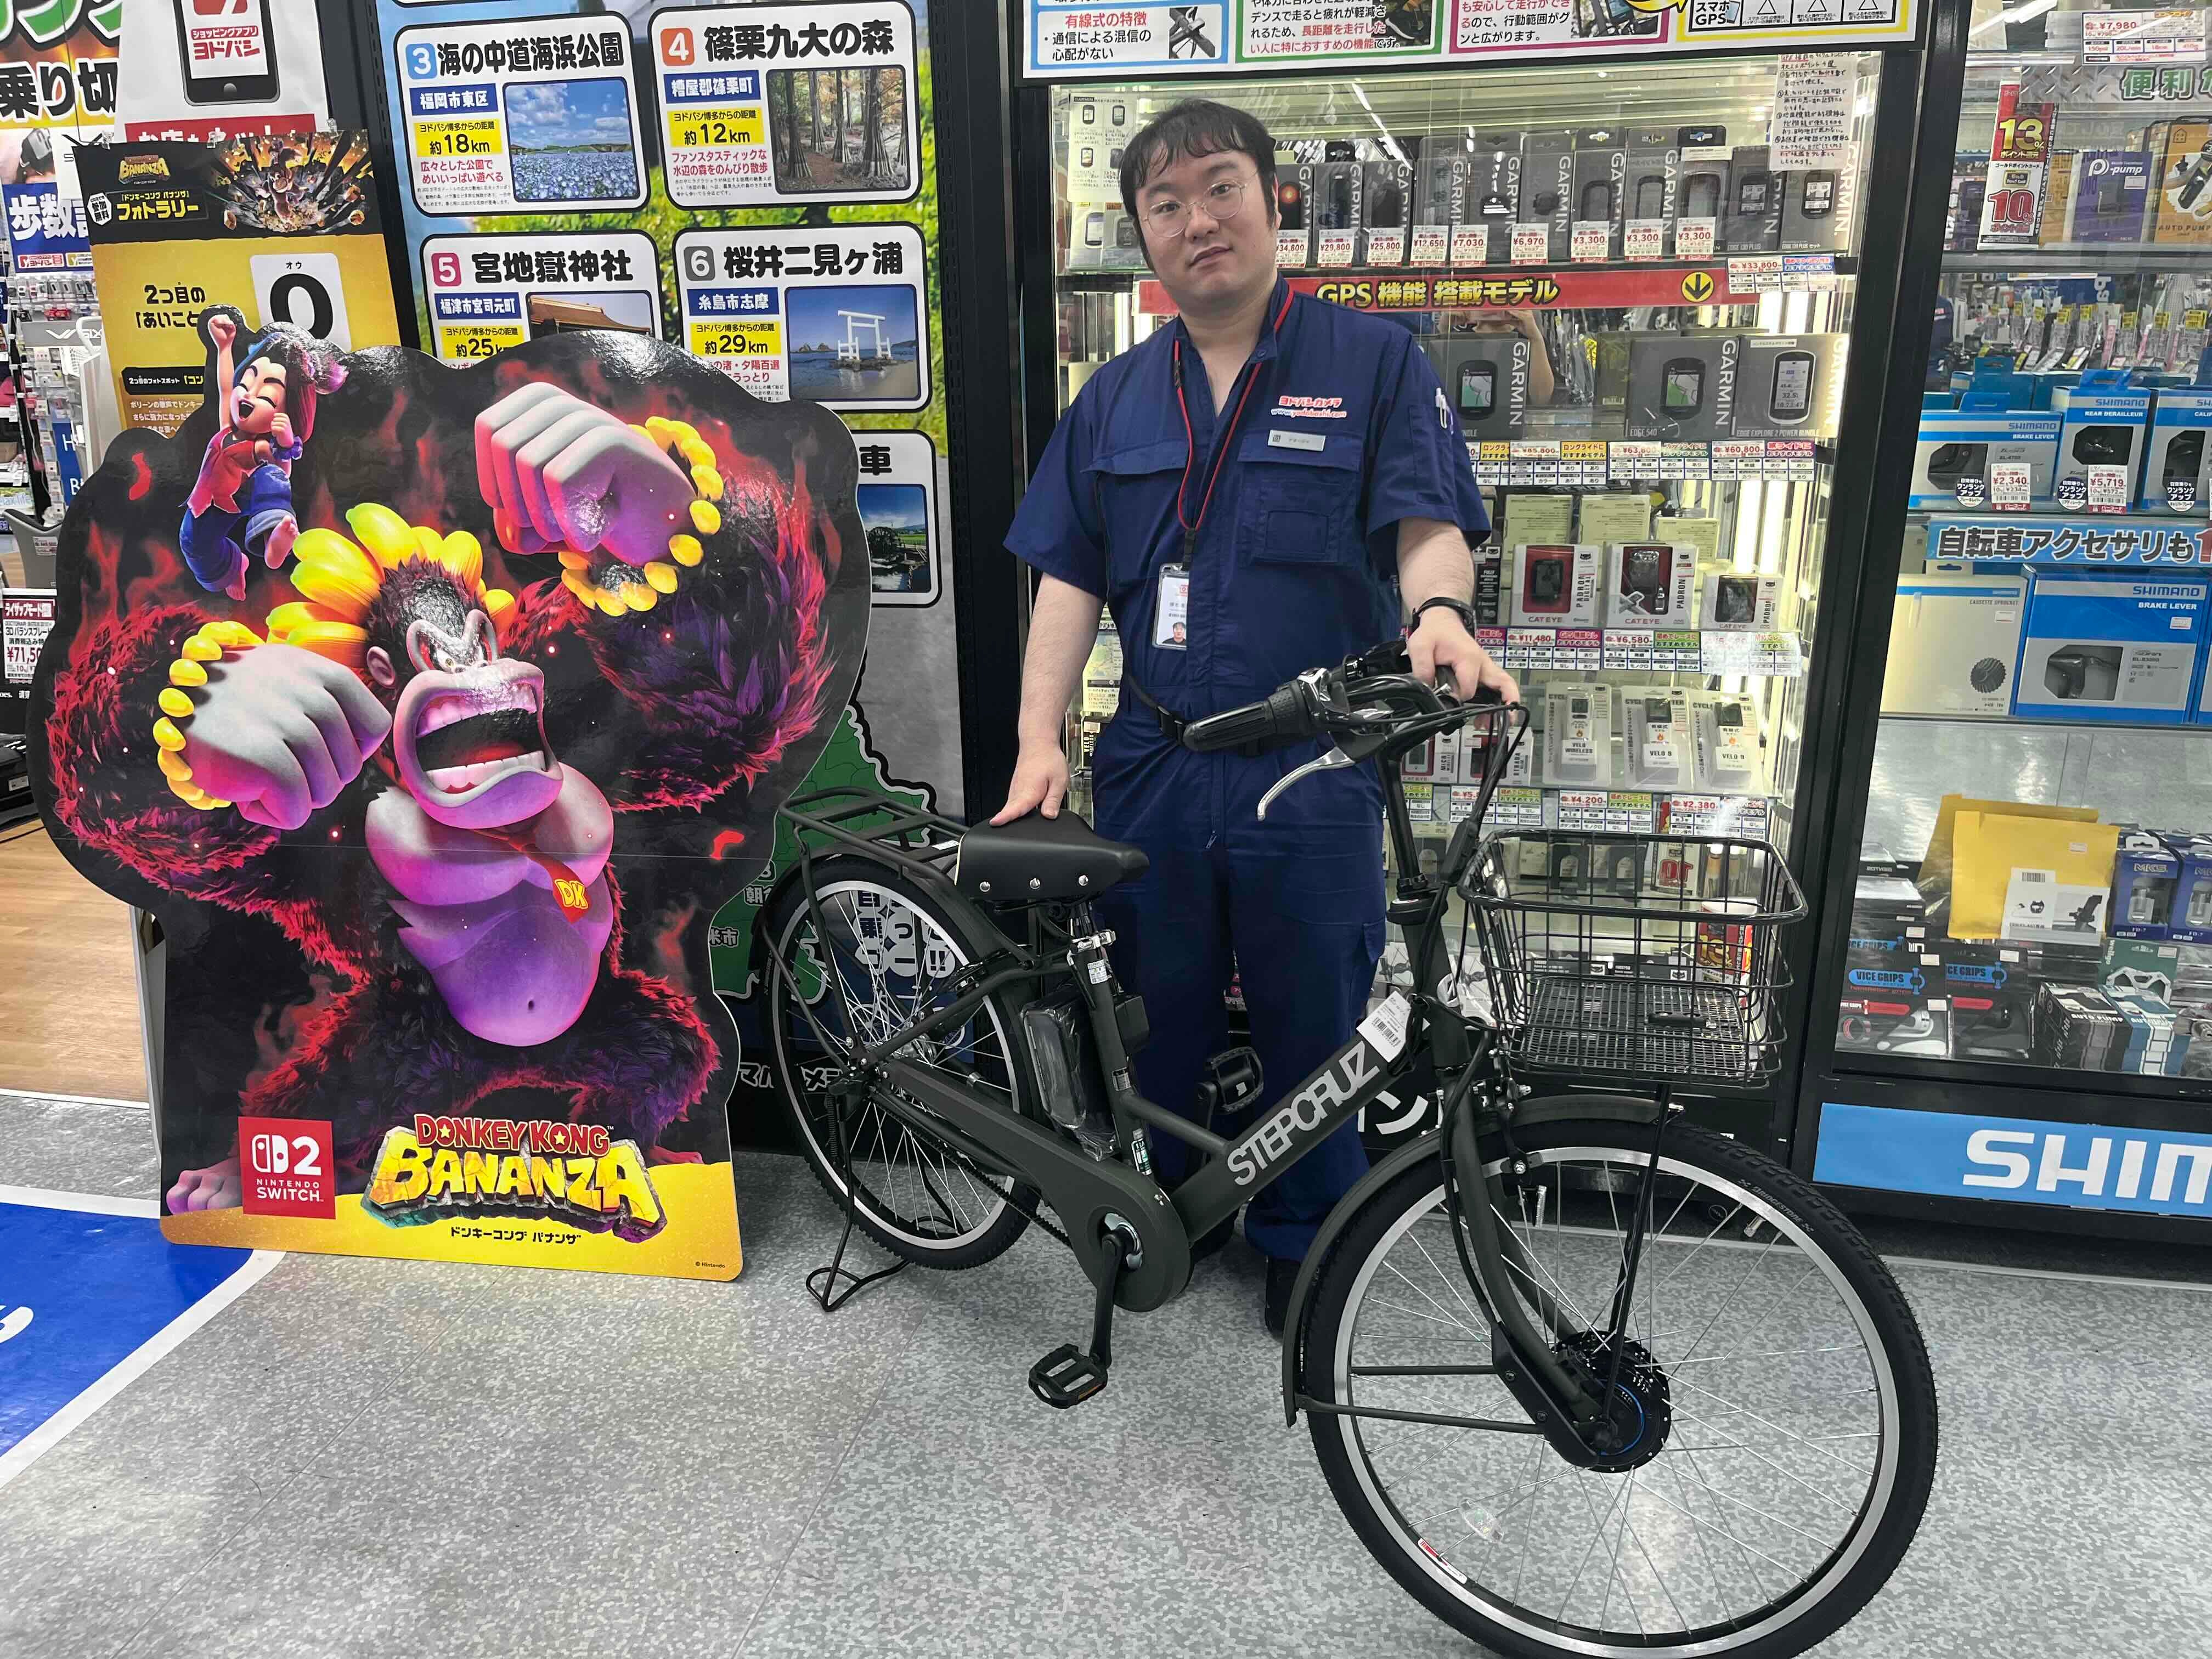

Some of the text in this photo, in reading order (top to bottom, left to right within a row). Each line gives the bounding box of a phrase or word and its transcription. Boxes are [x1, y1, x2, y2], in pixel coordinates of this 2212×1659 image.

[1696, 1, 1730, 13] スマホ
[1065, 12, 1147, 29] 有線式の特徴
[1251, 6, 1386, 23] デンスで走ると疲れが軽減さ
[1462, 12, 1570, 28] るので、行動範囲がグ
[1695, 13, 1726, 26] GPS
[1250, 21, 1386, 38] れるため、長距離を走行した
[2100, 21, 2137, 30] ¥7,980
[192, 27, 257, 38] ショッピングアプリ
[1460, 31, 1541, 44] ンと広がります。
[668, 20, 894, 62] 4 篠栗九大の森
[1250, 37, 1400, 53] い人に特におすすめの機能です。
[194, 40, 259, 59] ヨドバシ
[413, 32, 624, 76] 3 海の中道海浜公園
[1052, 48, 1113, 61] 心配がない
[420, 90, 488, 110] 福岡市東区
[674, 110, 757, 121] ヨドバシ博多からの距離
[419, 121, 495, 133] ヨドバシ博多からの距離
[672, 150, 766, 162] ファンスタスティックな
[420, 160, 493, 172] 広々とした公園で
[673, 163, 768, 177] 水辺の森をのんびり散歩
[422, 172, 504, 185] めいいっぱい遊べる
[1555, 155, 1571, 233] GARMIN
[116, 200, 199, 221] フォトラリー
[1513, 238, 1544, 246] ¥6,970
[1573, 236, 1605, 245] ¥3,300
[1627, 234, 1658, 242] ¥3,300
[1678, 232, 1711, 240] ¥3,300
[1321, 243, 1350, 252] ¥29,800
[1370, 242, 1400, 251] ¥25,800
[1414, 239, 1444, 247] ¥12,650
[1453, 239, 1483, 247] ¥7,030
[438, 250, 633, 284] 5 宮地嶽神社
[691, 251, 710, 277] 6
[144, 285, 206, 303] 2つ目の
[1317, 278, 1560, 307] GPS 機能 搭載モデル
[440, 298, 516, 314] 福津市宮司元町
[698, 294, 769, 311] 糸島市志摩
[696, 323, 775, 332] ヨドバシ博多からの距離
[456, 338, 516, 358] 約25k
[1508, 341, 1530, 426] GARMIN
[1716, 340, 1737, 426] GARMIN
[1279, 396, 1342, 408] ヨドバシカメラ
[2095, 399, 2146, 407] SHIMANO
[2008, 422, 2057, 431] SHIMANO
[859, 445, 892, 476] 車
[1993, 477, 2027, 486] ¥2,340
[2090, 478, 2125, 488] ¥5,719
[1939, 527, 2193, 562] 自転車アクセサリも
[1677, 579, 1686, 609] PADRON
[2133, 585, 2199, 597] SHIMANO
[1616, 636, 1650, 645] ¥6,580
[1571, 796, 1603, 804] ¥4,200
[1683, 800, 1716, 809] ¥2,380
[2133, 864, 2168, 873] MKS
[555, 879, 588, 909] DK
[1856, 971, 1904, 983] VICE GRIPS
[1959, 966, 1986, 977] GRIPS
[1227, 1040, 1380, 1186] STEPCRUZ
[414, 1114, 610, 1156] DONKEY KONG
[293, 1136, 321, 1176] 2
[257, 1178, 320, 1189] NINTENDO
[369, 1146, 662, 1226] BANANZA
[257, 1187, 320, 1201] SWITCH
[1751, 1186, 1803, 1223] BRIDGESTONE
[450, 1227, 582, 1244] ドンキーコング バナンザ
